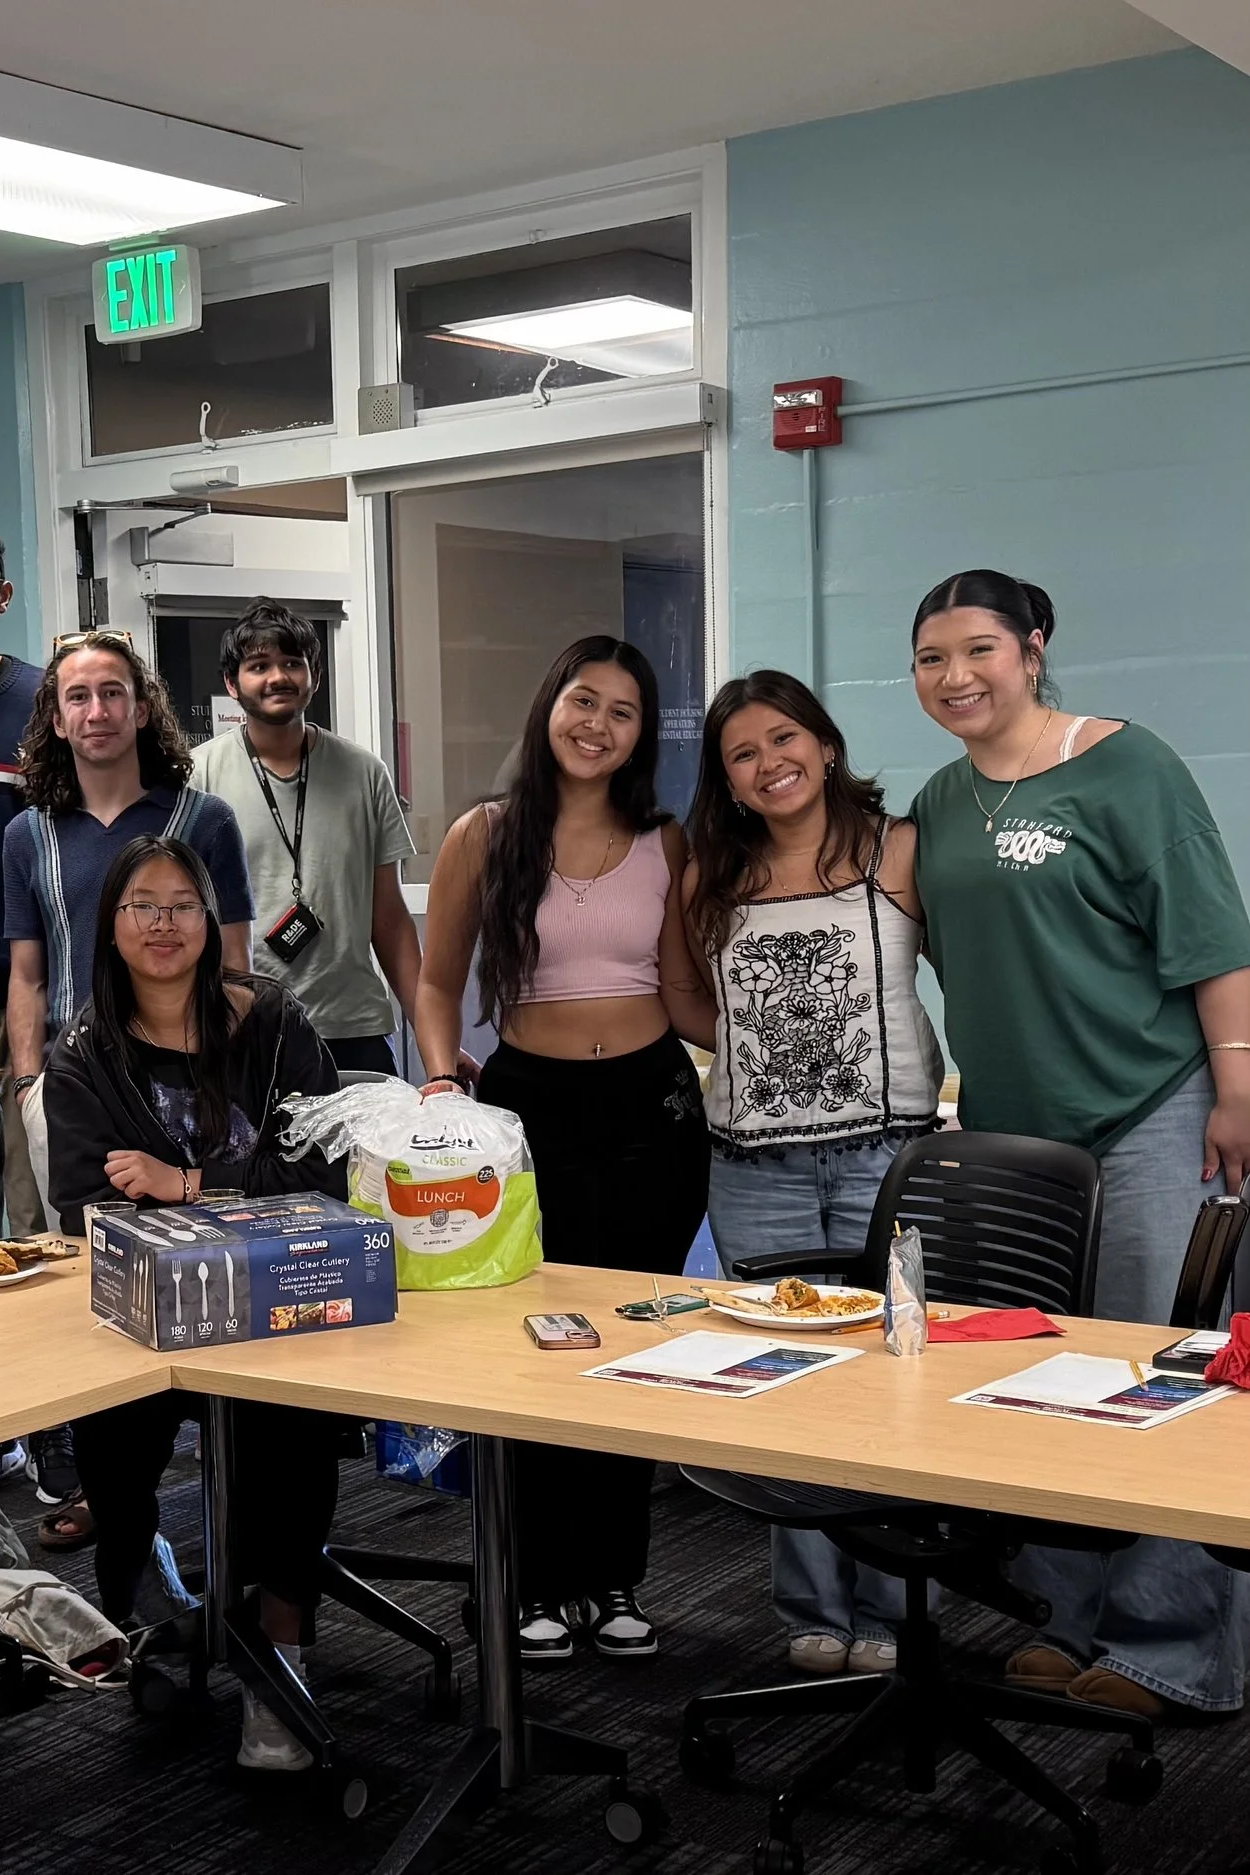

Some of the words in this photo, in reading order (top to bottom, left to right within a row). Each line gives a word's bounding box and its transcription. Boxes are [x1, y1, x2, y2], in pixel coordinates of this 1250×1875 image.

[107, 250, 176, 333] EXIT
[1003, 818, 1072, 838] STANFORD
[281, 919, 302, 942] R&DE
[422, 1154, 467, 1167] CLASSIC
[478, 1167, 494, 1179] 225
[417, 1190, 465, 1204] LUNCH
[289, 1240, 329, 1252] KIRKLAND
[363, 1232, 390, 1250] 360
[269, 1259, 298, 1274] Crystal
[299, 1260, 320, 1270] Clear
[321, 1256, 350, 1267] Cutlery
[198, 1322, 213, 1333] 120
[225, 1318, 238, 1329] 60
[171, 1325, 187, 1337] 180
